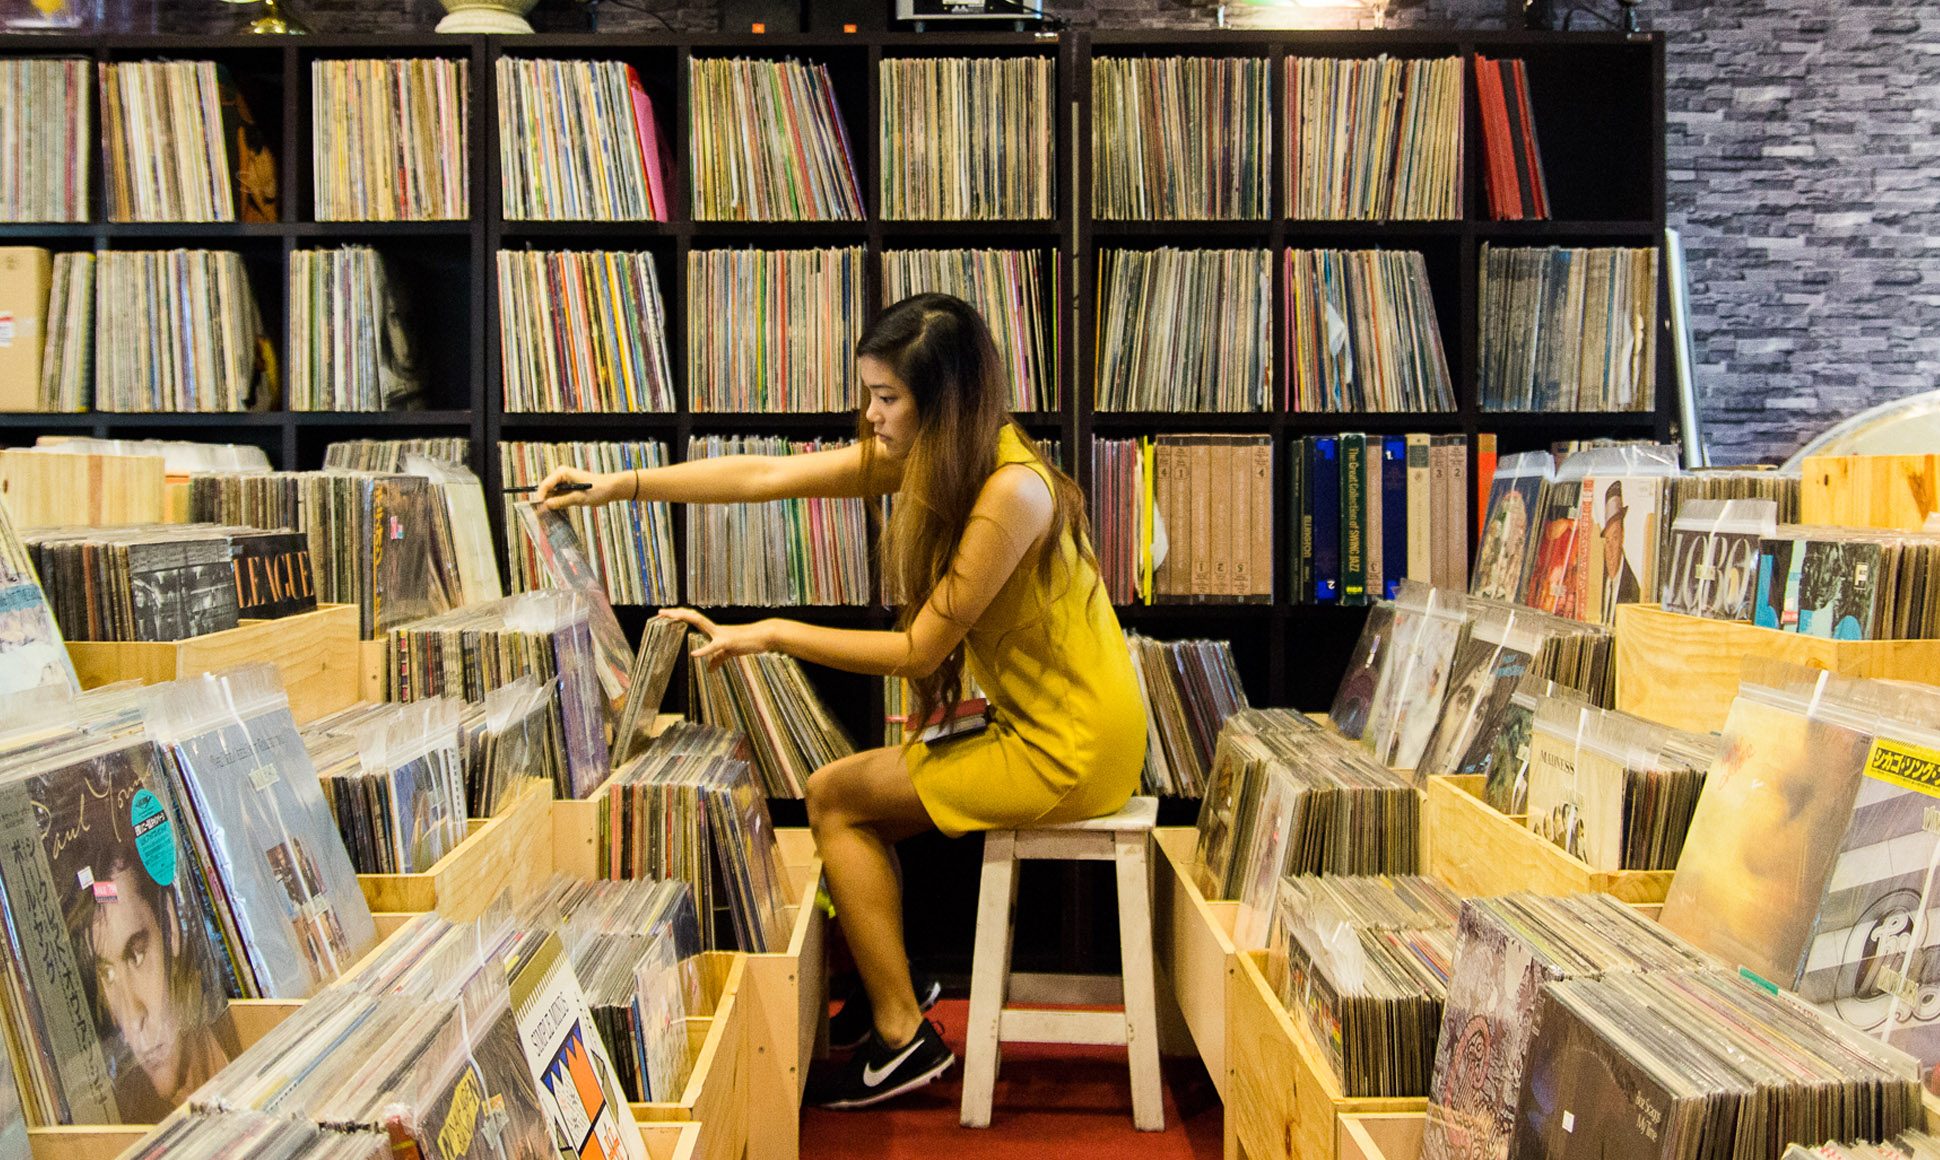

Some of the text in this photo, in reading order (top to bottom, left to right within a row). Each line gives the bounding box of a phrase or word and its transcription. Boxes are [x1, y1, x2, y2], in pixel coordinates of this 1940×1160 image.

[1348, 462, 1359, 482] Great
[1348, 483, 1359, 520] Collection
[1348, 530, 1360, 555] SWING
[1348, 555, 1360, 573] JAZZ
[1540, 749, 1576, 776] MADNESS
